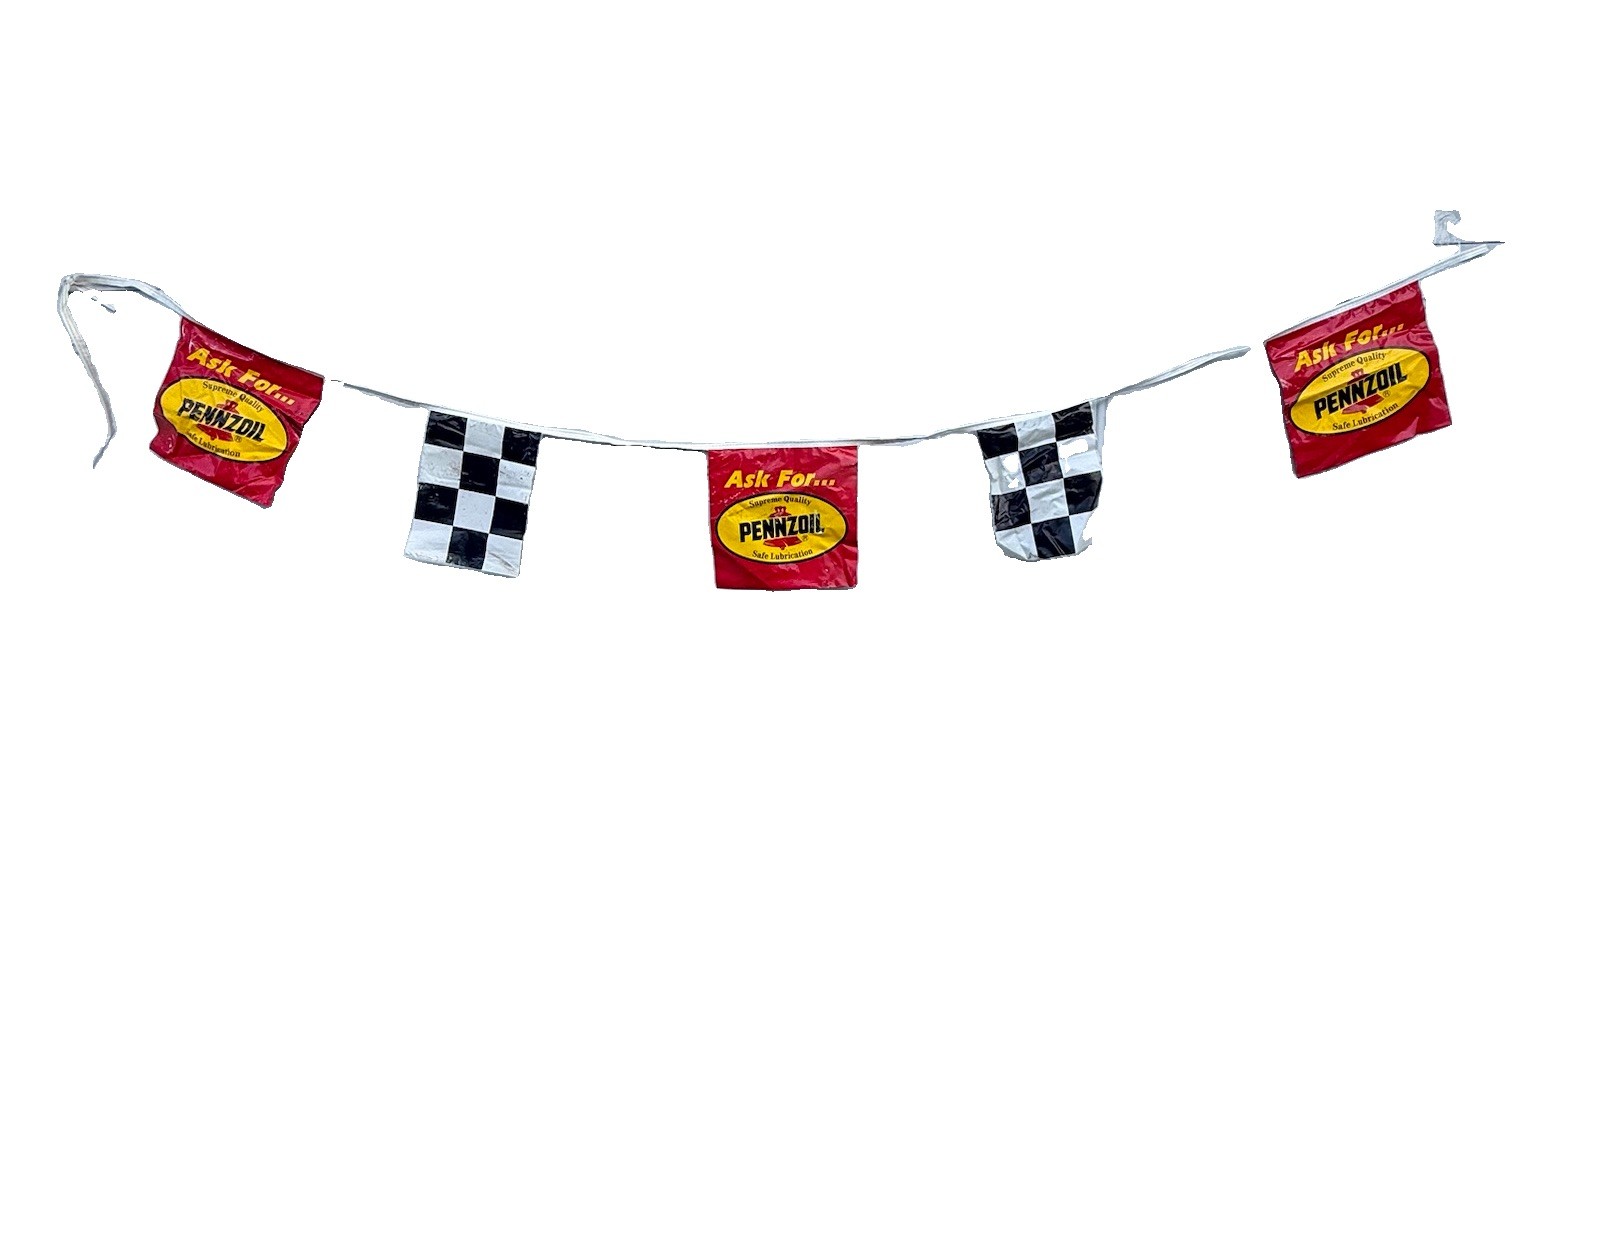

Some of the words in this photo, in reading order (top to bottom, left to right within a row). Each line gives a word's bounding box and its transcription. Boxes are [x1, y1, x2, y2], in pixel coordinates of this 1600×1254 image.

[187, 348, 238, 378] Ask
[1294, 342, 1337, 373] Ask
[1322, 361, 1355, 382] Supreme
[1357, 352, 1386, 364] Quality
[203, 381, 238, 398] Supreme
[239, 393, 264, 412] Quality
[1313, 363, 1408, 421] PENNZOIL
[177, 397, 266, 442] PENNZOIL
[1332, 422, 1350, 431] Safe
[1352, 403, 1399, 427] Lubrication
[198, 437, 240, 458] Lubrication
[724, 470, 770, 488] Ask
[749, 497, 781, 508] Supreme
[784, 495, 811, 506] Quality
[739, 513, 824, 542] PENNZOIL
[752, 550, 769, 559] Safe
[770, 549, 813, 560] Lubrication
